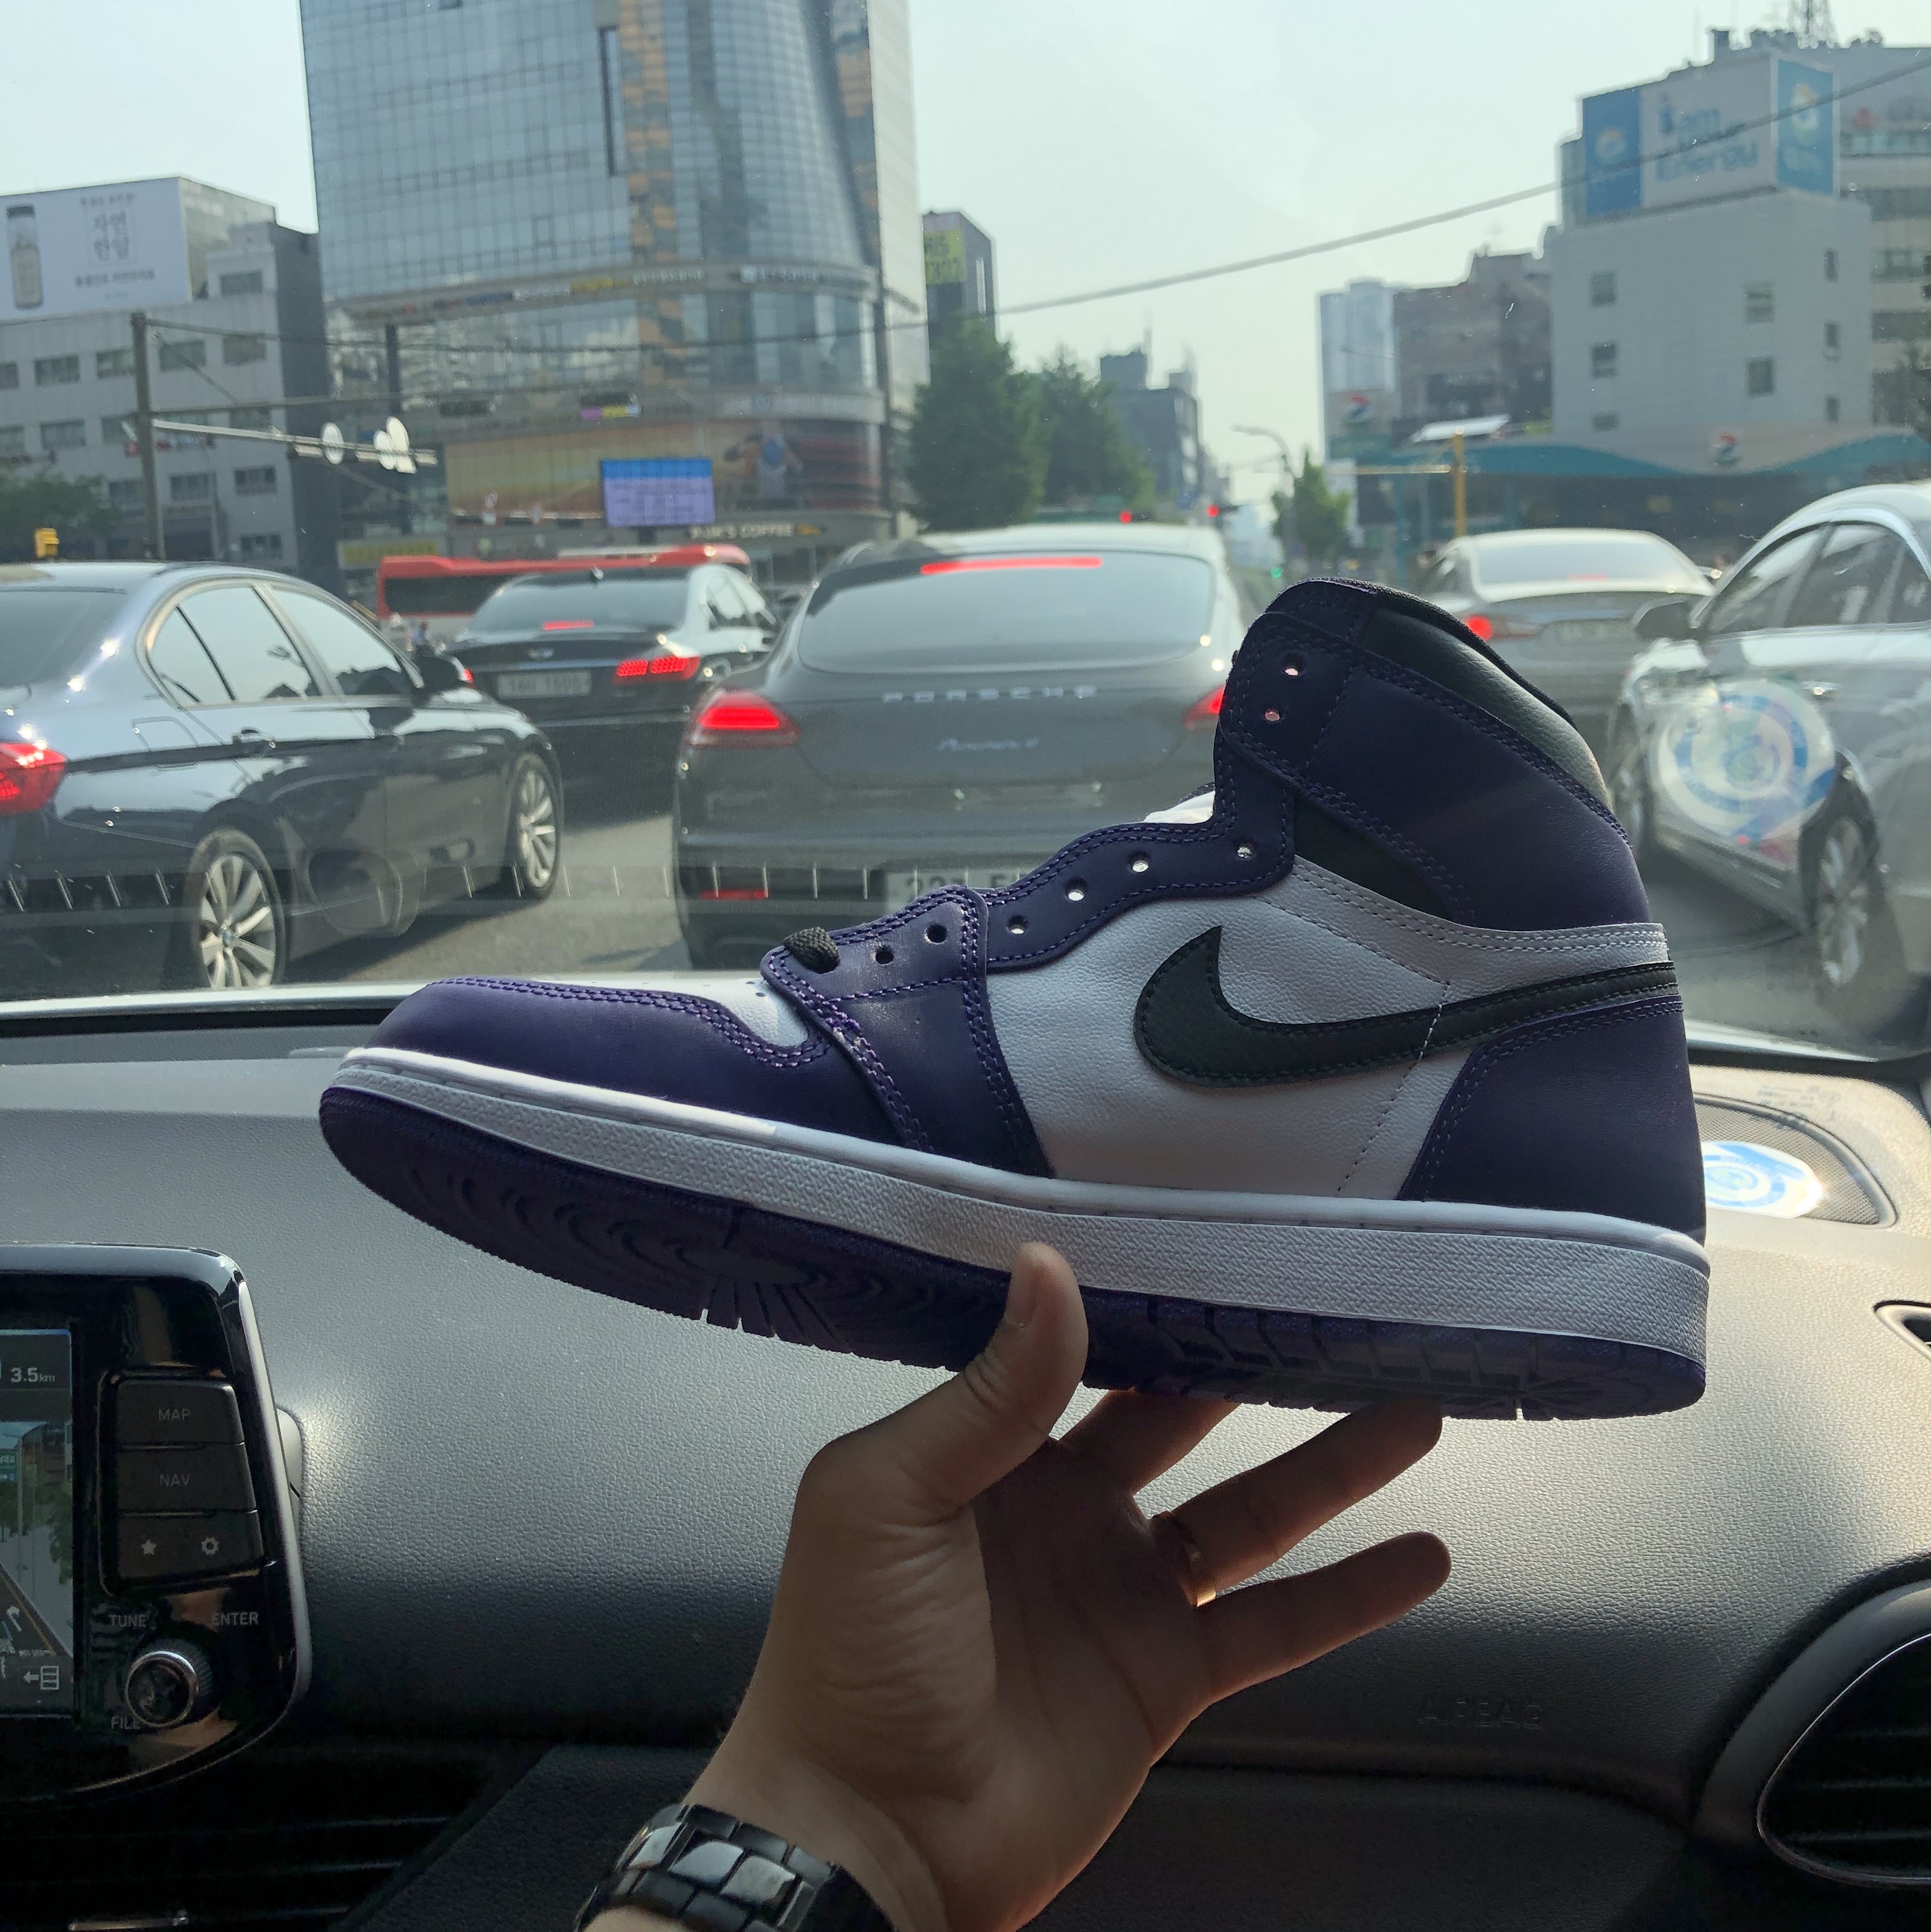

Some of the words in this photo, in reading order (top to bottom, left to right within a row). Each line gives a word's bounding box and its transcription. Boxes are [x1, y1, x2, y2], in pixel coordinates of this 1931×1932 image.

[158, 1408, 191, 1421] MAP
[160, 1473, 190, 1487] NAV
[109, 1614, 147, 1628] TUNE
[211, 1611, 259, 1626] ENTER
